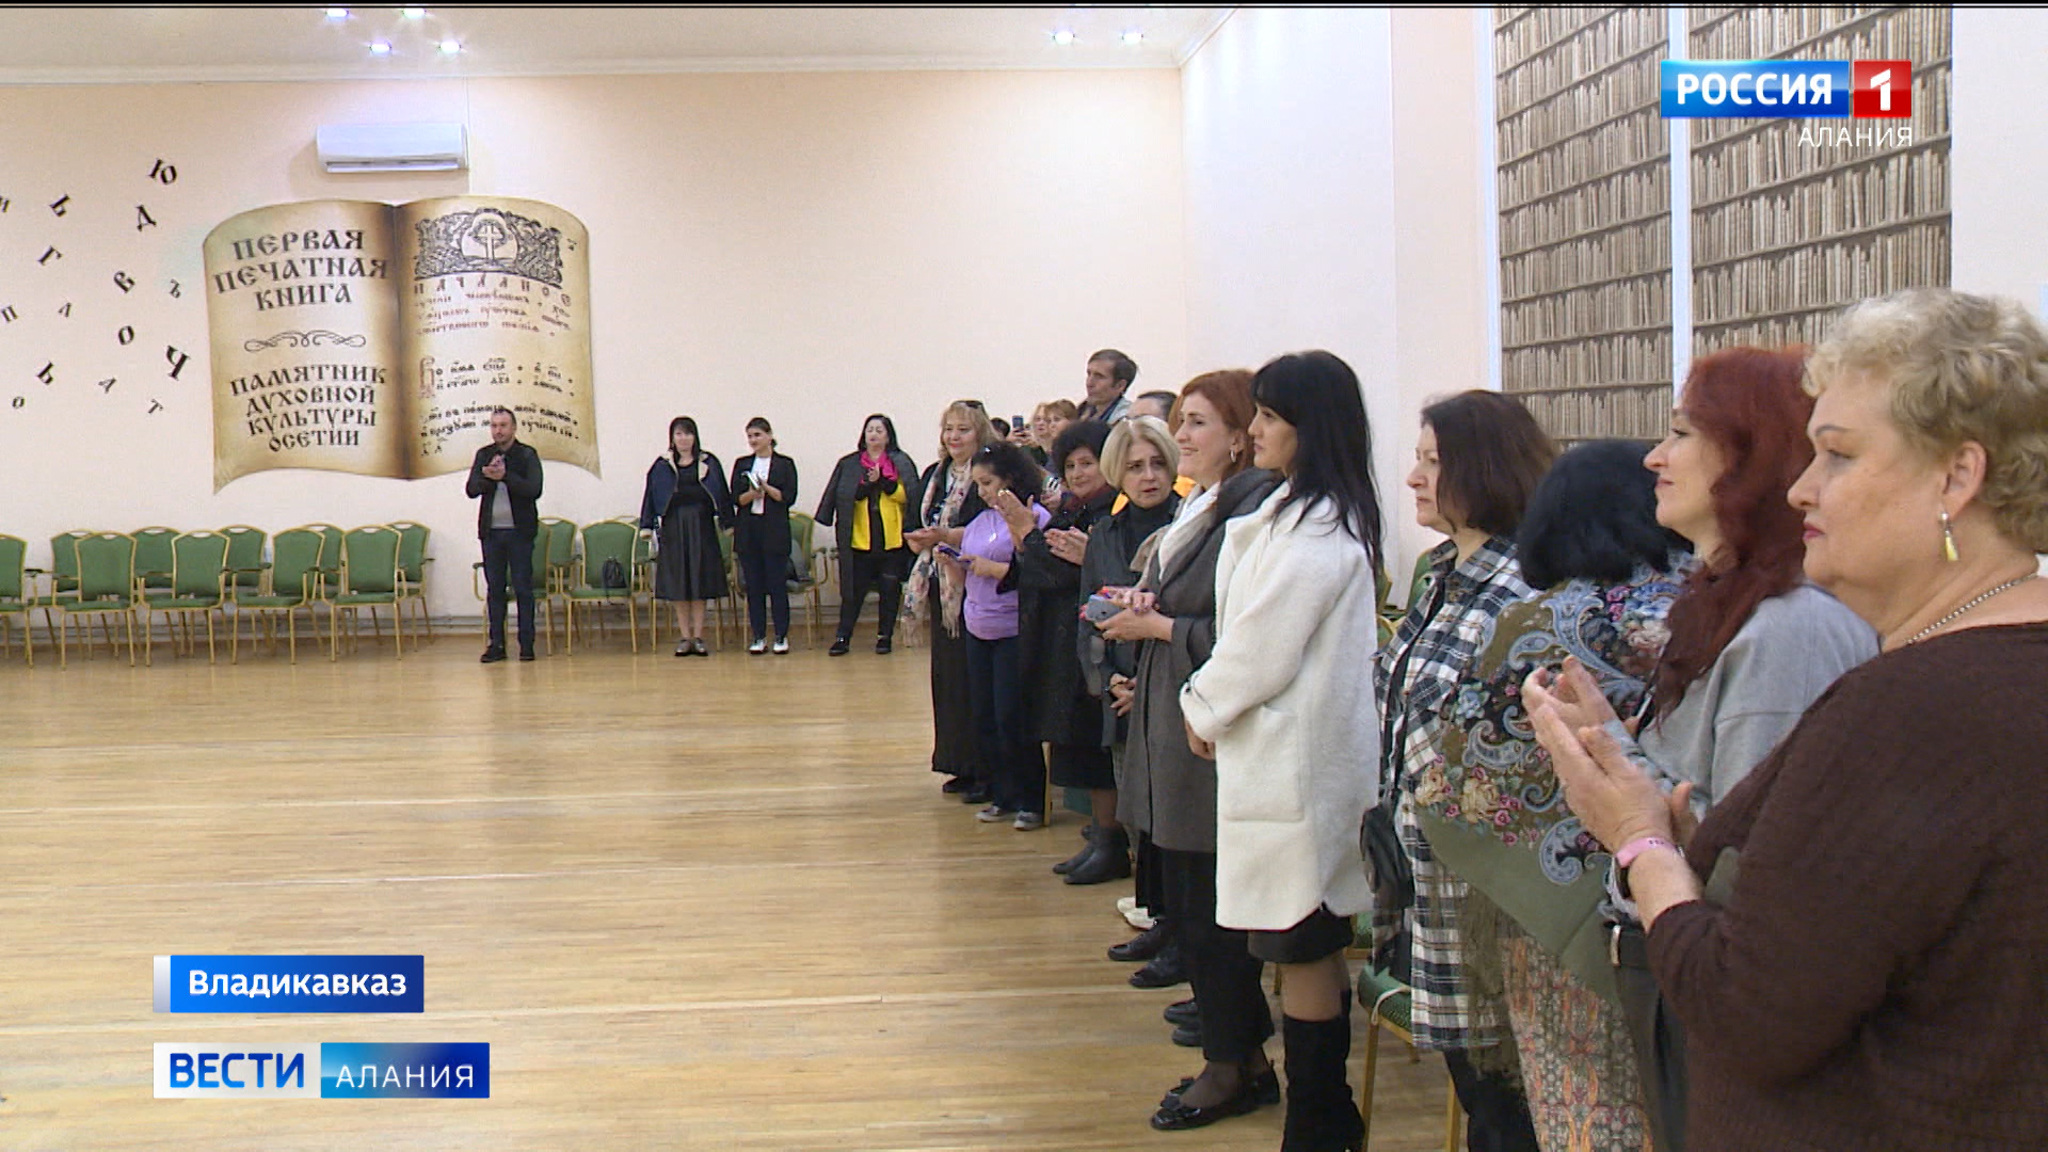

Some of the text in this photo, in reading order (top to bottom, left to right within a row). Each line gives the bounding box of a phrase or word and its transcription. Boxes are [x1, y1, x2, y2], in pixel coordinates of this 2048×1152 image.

[148, 158, 178, 186] Ю
[231, 229, 365, 260] ПЕРВАЯ
[213, 256, 388, 295] ПЕЧАТНАЯ
[254, 282, 353, 312] КНИГА
[230, 364, 387, 396] ПАМЯТНИК
[246, 385, 376, 418] ДУХОВНОЙ
[246, 408, 377, 437] КУЛЬТУРЫ
[268, 430, 360, 452] ОСЕТИИ
